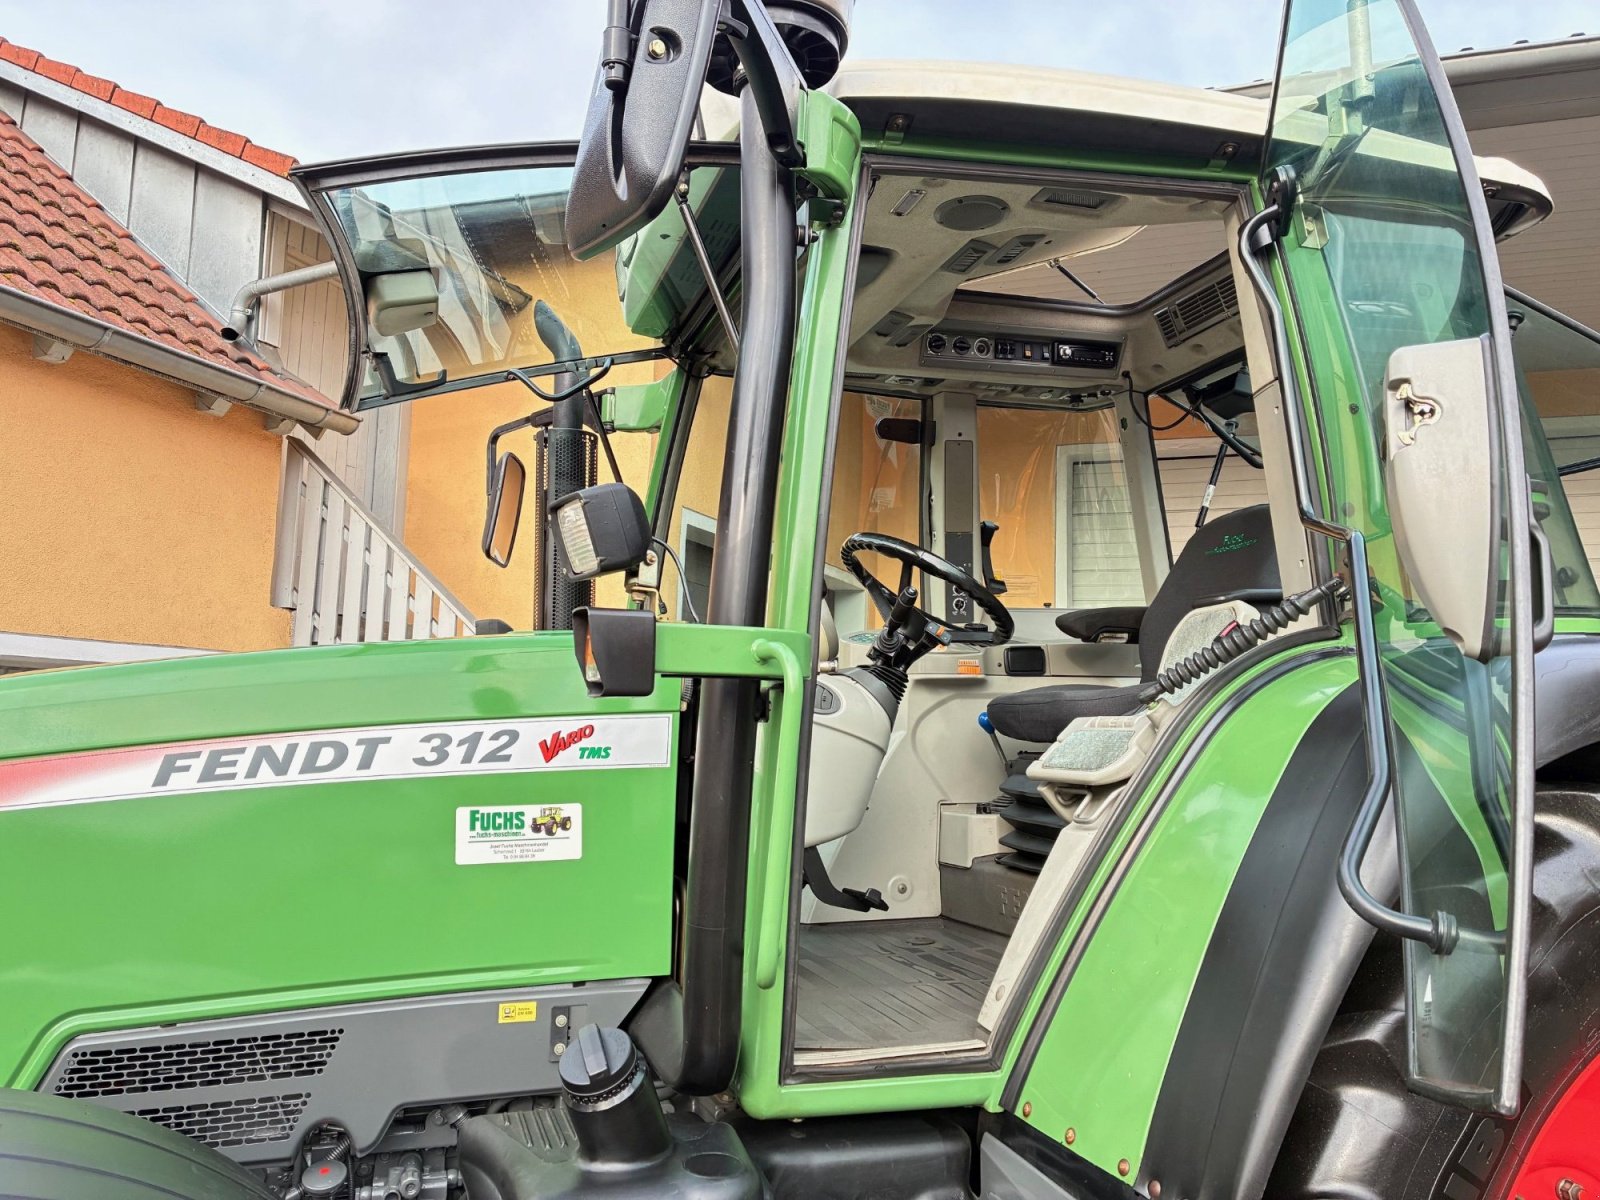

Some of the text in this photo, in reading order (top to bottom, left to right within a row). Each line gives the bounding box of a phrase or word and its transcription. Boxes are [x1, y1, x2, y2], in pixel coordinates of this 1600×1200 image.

[151, 729, 520, 788] FENDT 312
[538, 724, 595, 763] VARIO
[579, 746, 611, 760] TMS
[469, 809, 526, 832] FUCHS
